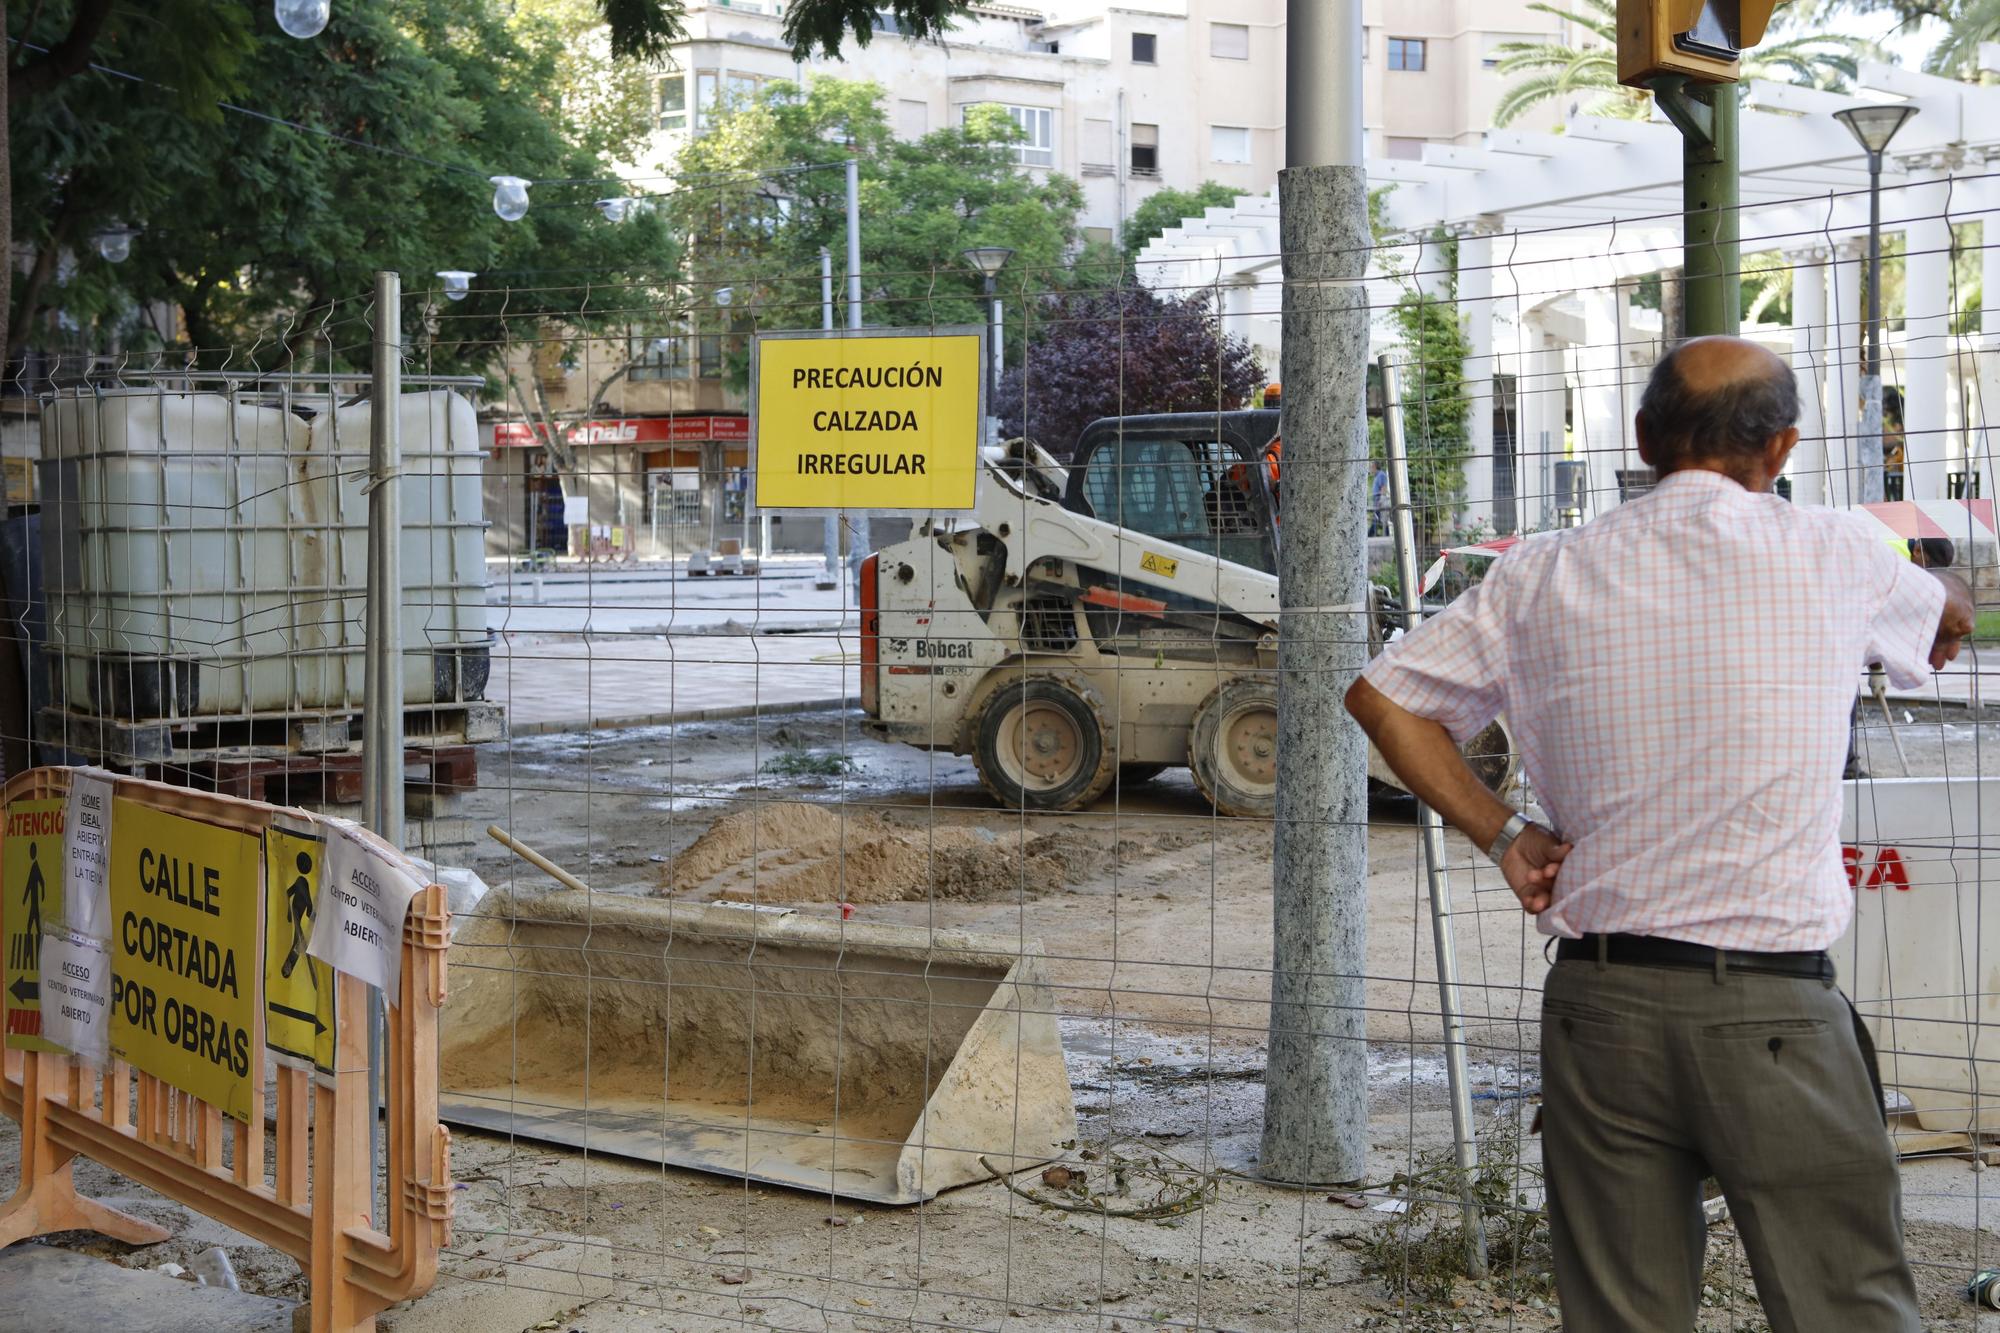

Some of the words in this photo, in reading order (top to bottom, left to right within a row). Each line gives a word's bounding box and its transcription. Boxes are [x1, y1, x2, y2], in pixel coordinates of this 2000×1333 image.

[792, 361, 943, 389] PRECAUCIÓN
[812, 410, 919, 432] CALZADA
[797, 453, 926, 475] IRREGULAR
[916, 640, 974, 658] Bobcat
[81, 793, 101, 809] HOME
[80, 812, 101, 828] IDEAL
[77, 830, 104, 847] ABIERTA
[74, 866, 84, 878] LA
[138, 847, 221, 916] CALLE
[352, 868, 381, 897] ACCESO
[330, 884, 358, 907] CENTRO
[343, 919, 384, 950] ABIERTO
[122, 910, 239, 1000] CORTADA
[62, 961, 90, 979] ACCESO
[47, 979, 68, 994] CENTRO
[69, 986, 105, 1007] VETERINARIO
[60, 1004, 91, 1025] ABIERTO
[112, 973, 157, 1035] POR
[164, 997, 249, 1078] OBRAS
